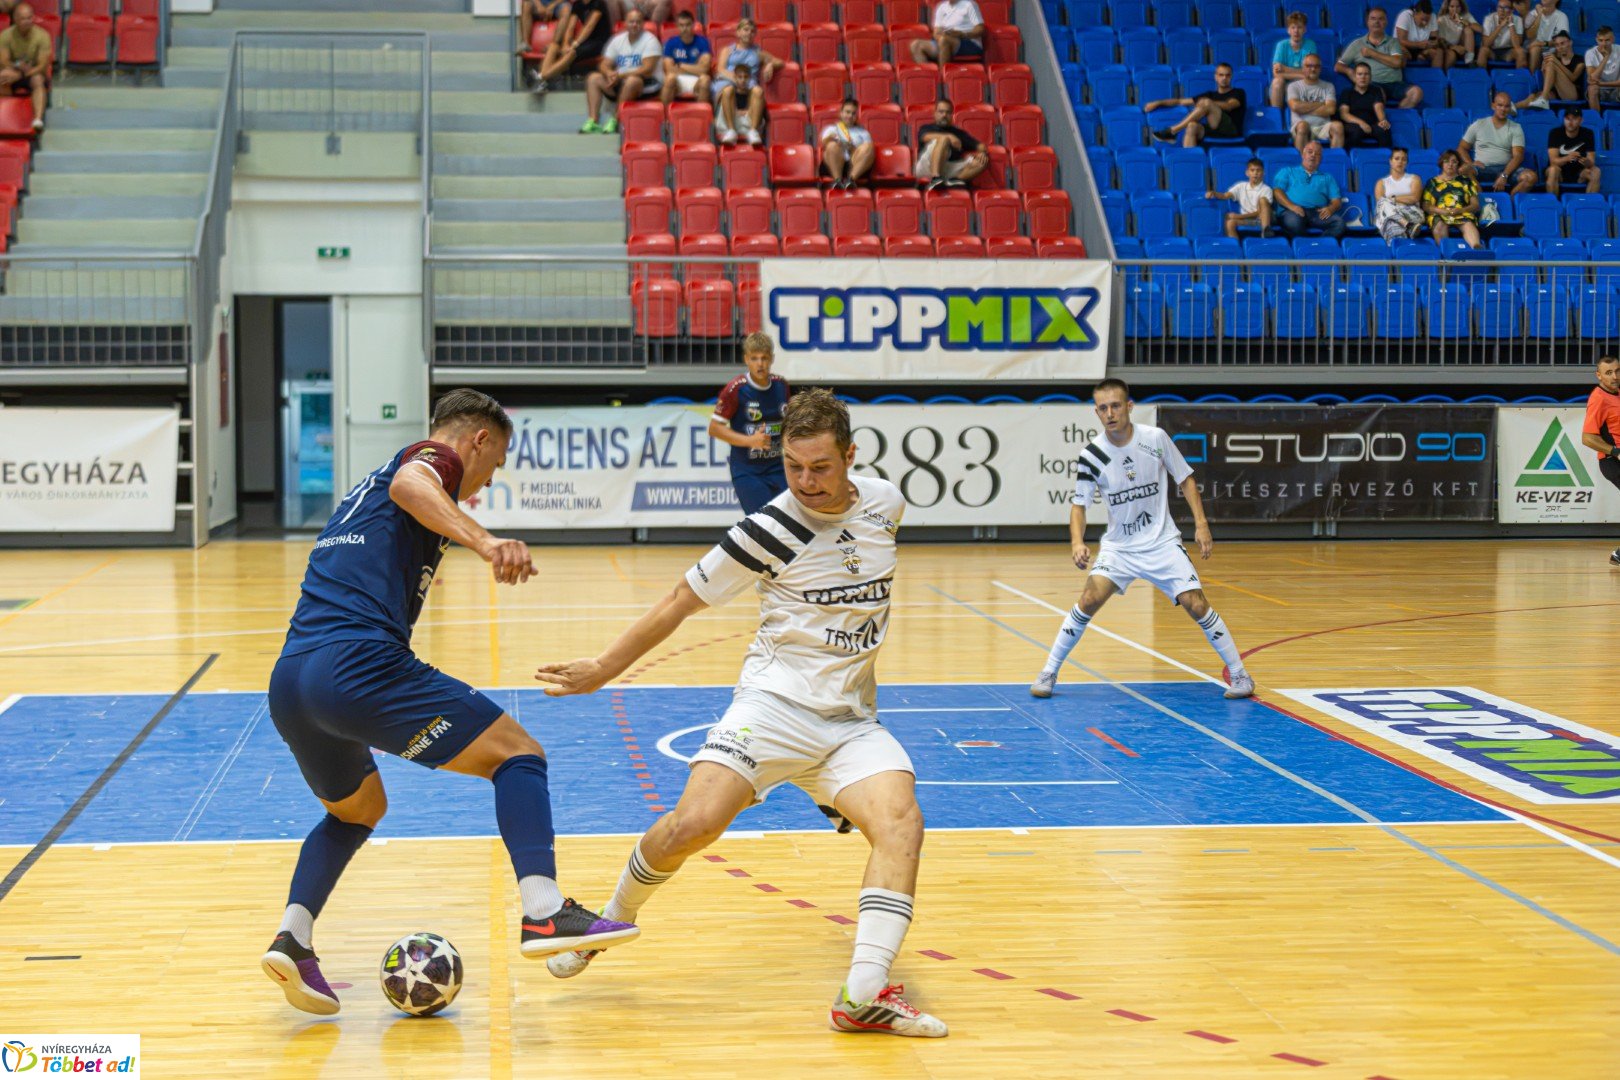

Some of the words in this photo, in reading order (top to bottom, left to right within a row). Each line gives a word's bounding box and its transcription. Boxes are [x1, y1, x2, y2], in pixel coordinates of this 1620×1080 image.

[773, 291, 1097, 347] TiPPMIX
[1062, 423, 1098, 443] the
[640, 425, 677, 468] AZ
[690, 425, 731, 468] EL
[1416, 432, 1486, 462] 90
[2, 456, 148, 485] EGYHÁZA
[521, 482, 527, 495] F
[531, 482, 577, 495] MEDICAL
[1432, 482, 1478, 497] KFT
[1516, 490, 1572, 504] KE-VIZ
[1574, 490, 1593, 504] 21
[430, 720, 452, 739] FM
